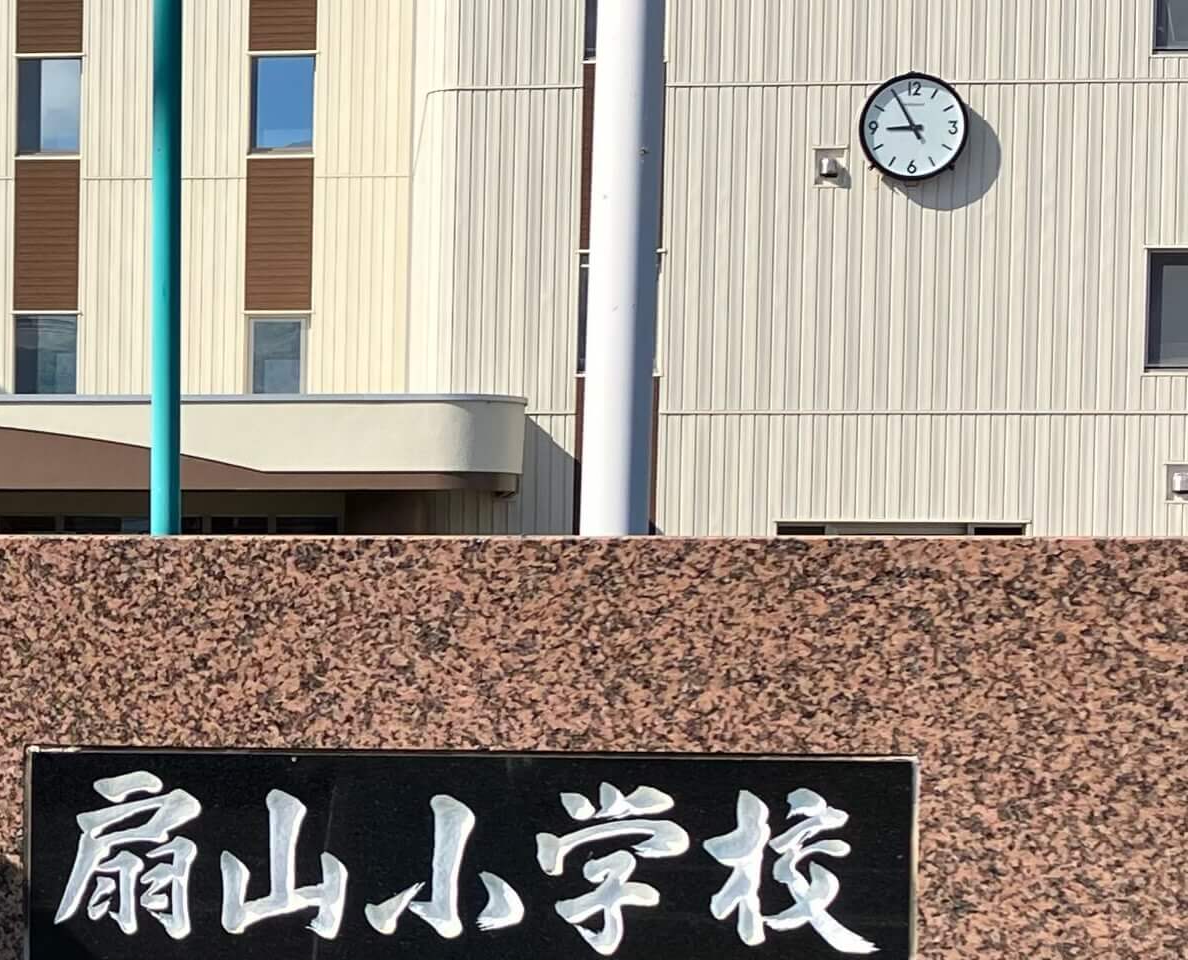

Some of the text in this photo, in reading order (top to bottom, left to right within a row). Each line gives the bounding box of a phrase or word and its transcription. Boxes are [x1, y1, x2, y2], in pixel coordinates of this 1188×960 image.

[907, 81, 922, 97] 12
[868, 120, 879, 136] 9
[948, 120, 958, 135] 3
[907, 159, 917, 174] 6
[53, 771, 882, 956] 扇山小学校
